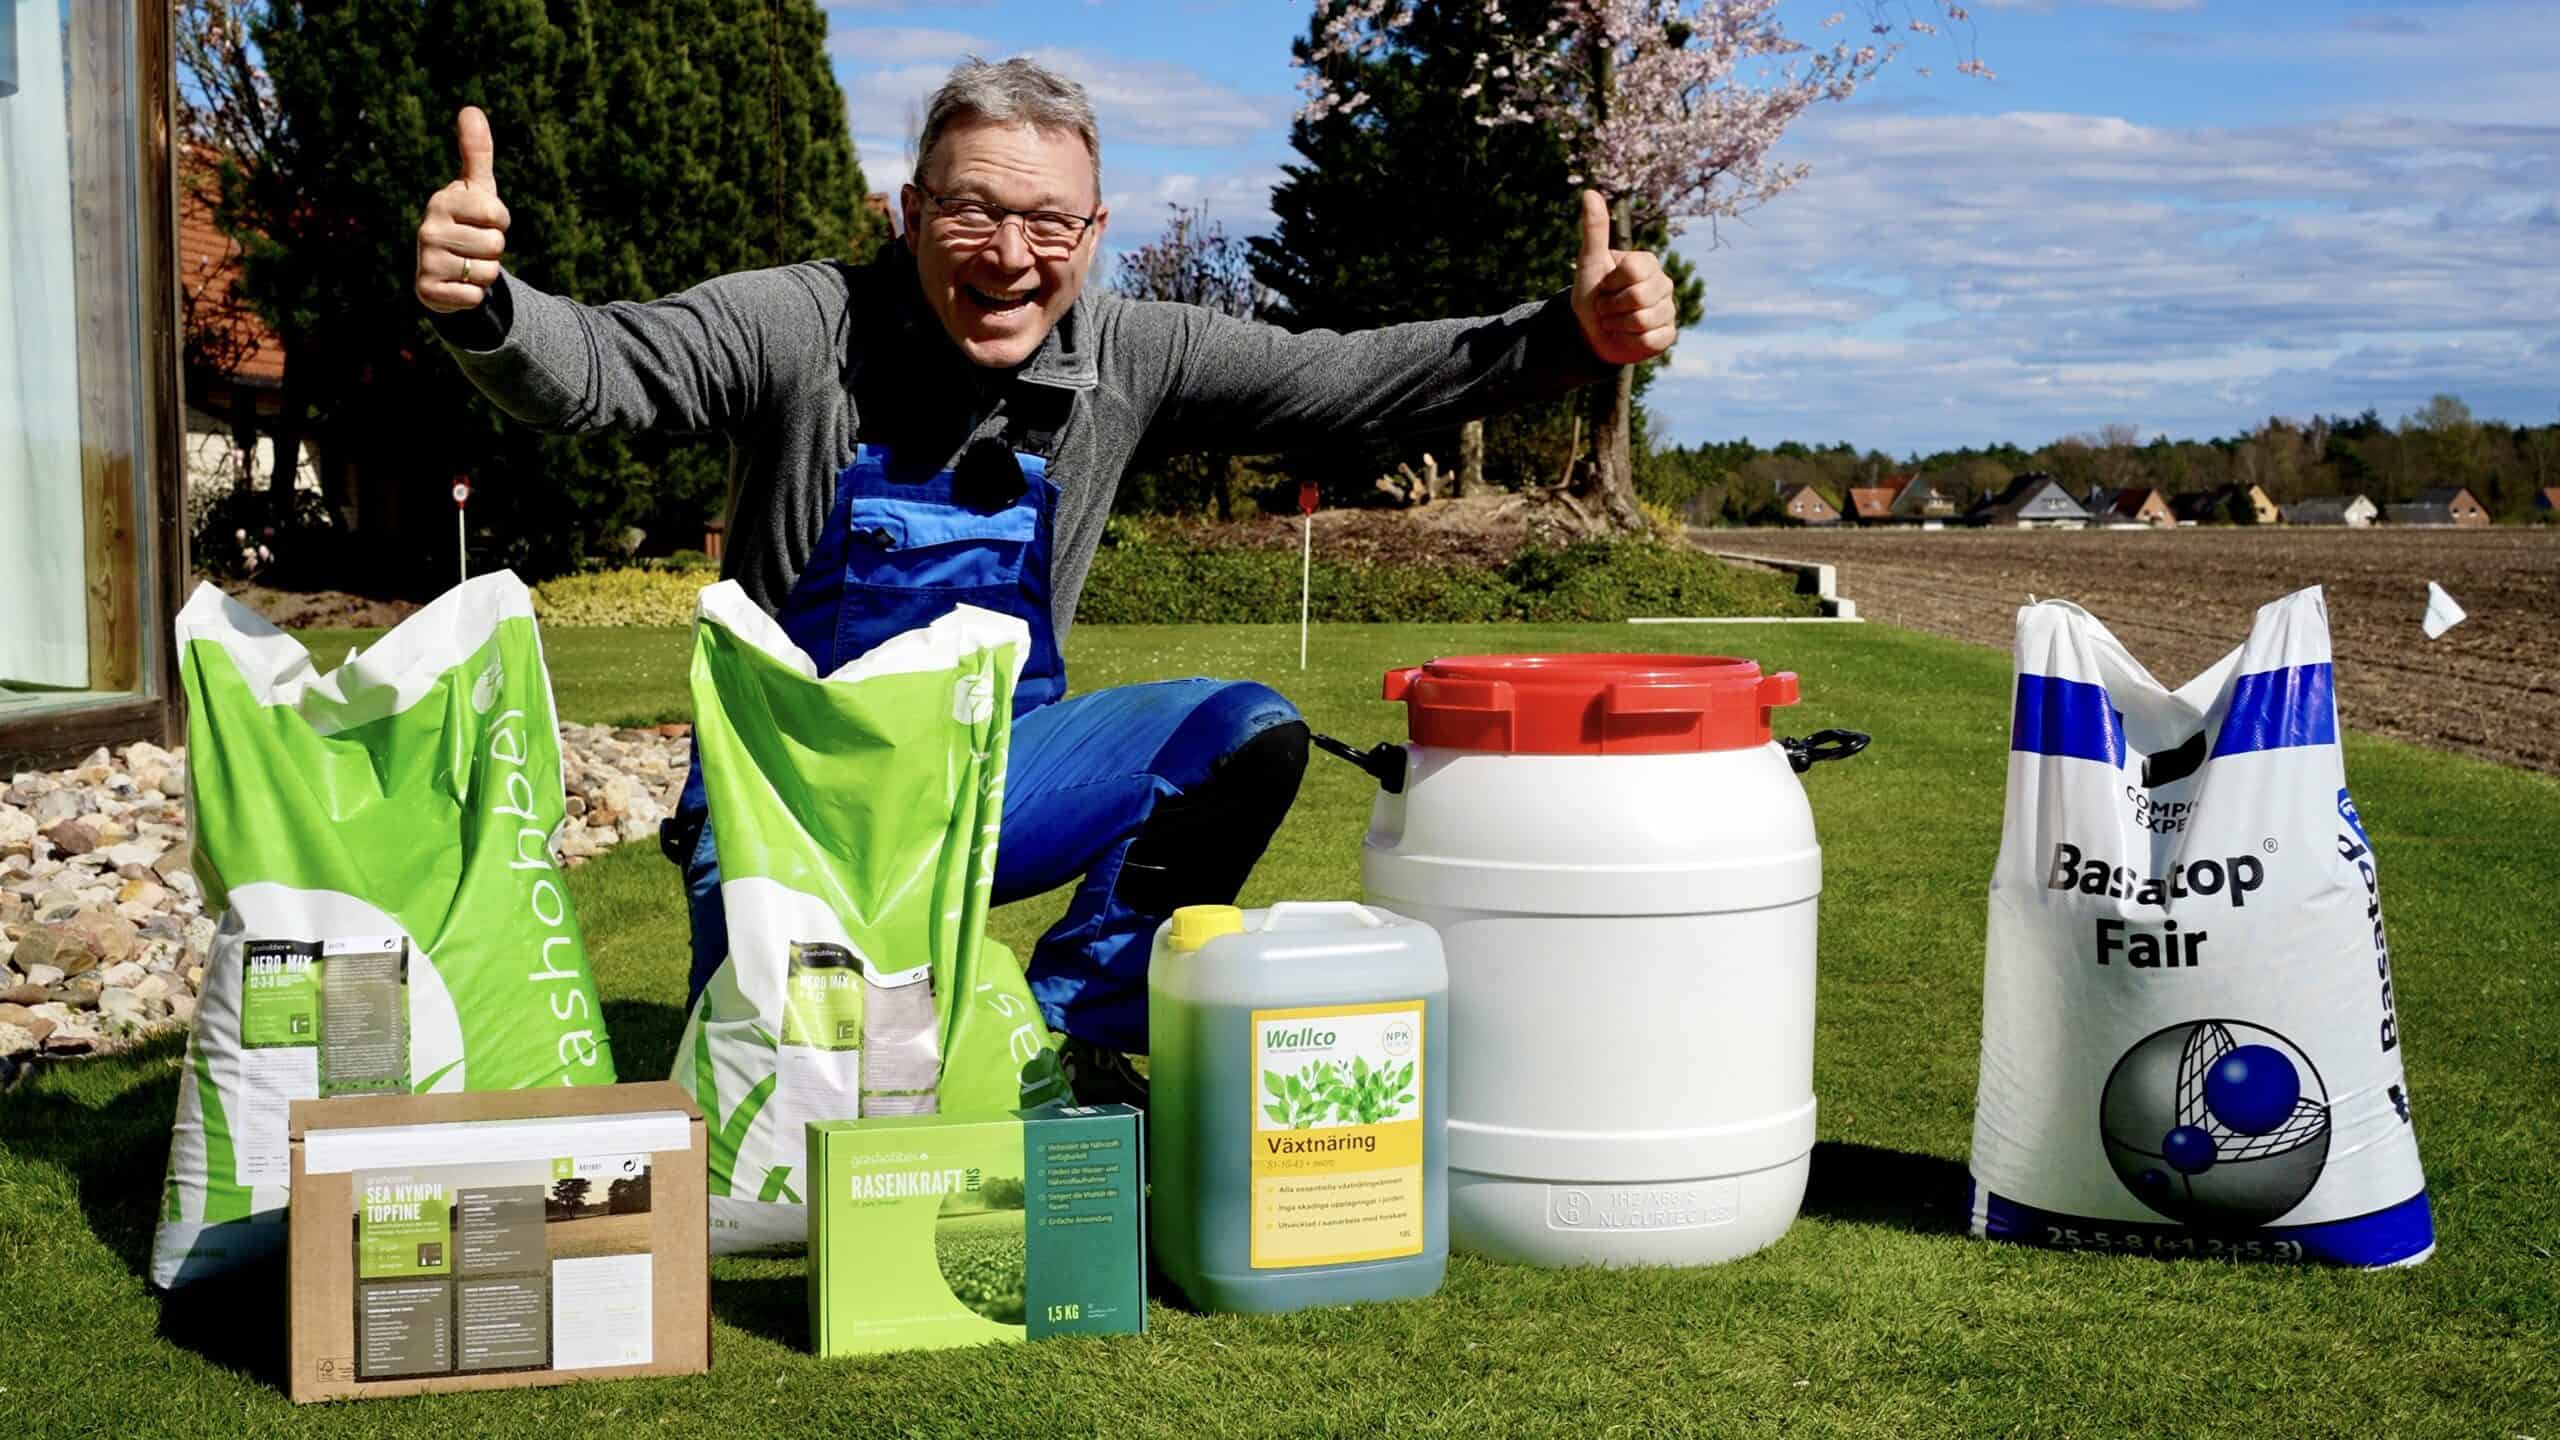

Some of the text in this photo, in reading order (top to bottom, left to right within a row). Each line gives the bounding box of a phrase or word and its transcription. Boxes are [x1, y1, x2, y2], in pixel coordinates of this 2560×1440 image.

[2096, 918, 2208, 968] Fair
[250, 954, 313, 976] NERO MIX
[1266, 1027, 1337, 1049] Wallco
[1386, 1031, 1409, 1041] NPK
[1267, 1134, 1376, 1154] Växtnäring
[367, 1183, 442, 1204] SEA NYMPH
[851, 1167, 981, 1199] RASENKRAFT EINS
[367, 1203, 422, 1223] TOPFINE
[2048, 1226, 2303, 1262] 25-5-8 (+12+53)
[1047, 1304, 1063, 1324] 1,5
[1064, 1304, 1080, 1321] KG
